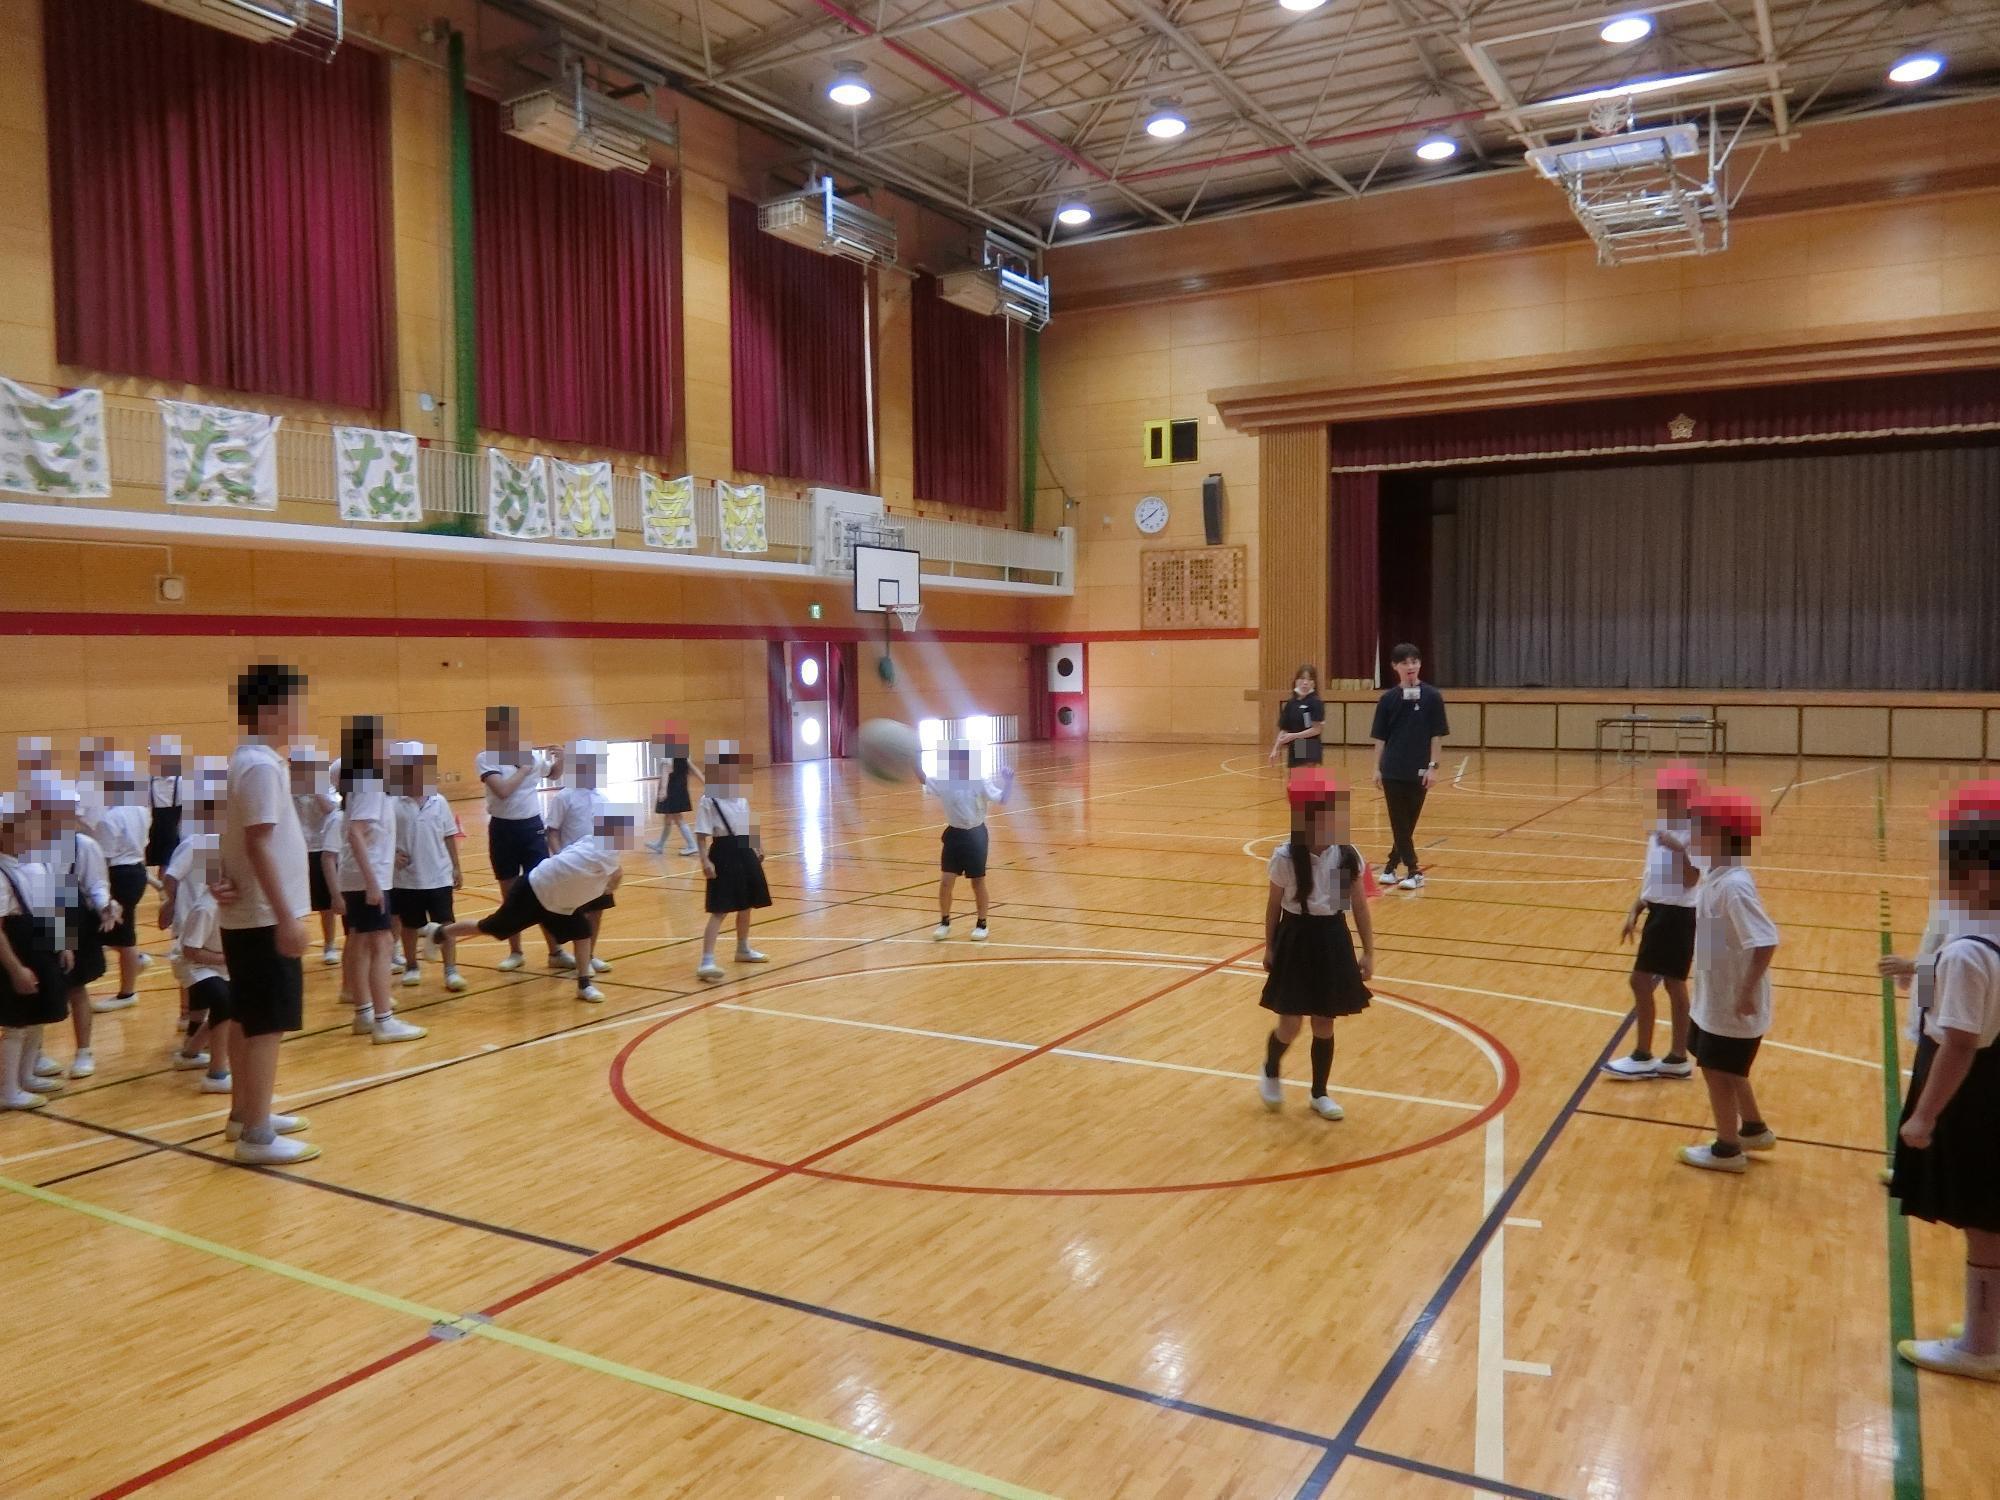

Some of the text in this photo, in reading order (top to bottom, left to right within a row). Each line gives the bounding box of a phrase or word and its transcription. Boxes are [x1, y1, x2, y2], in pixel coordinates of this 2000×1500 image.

[181, 414, 256, 492] た
[350, 434, 414, 513] な
[561, 468, 609, 535] 小
